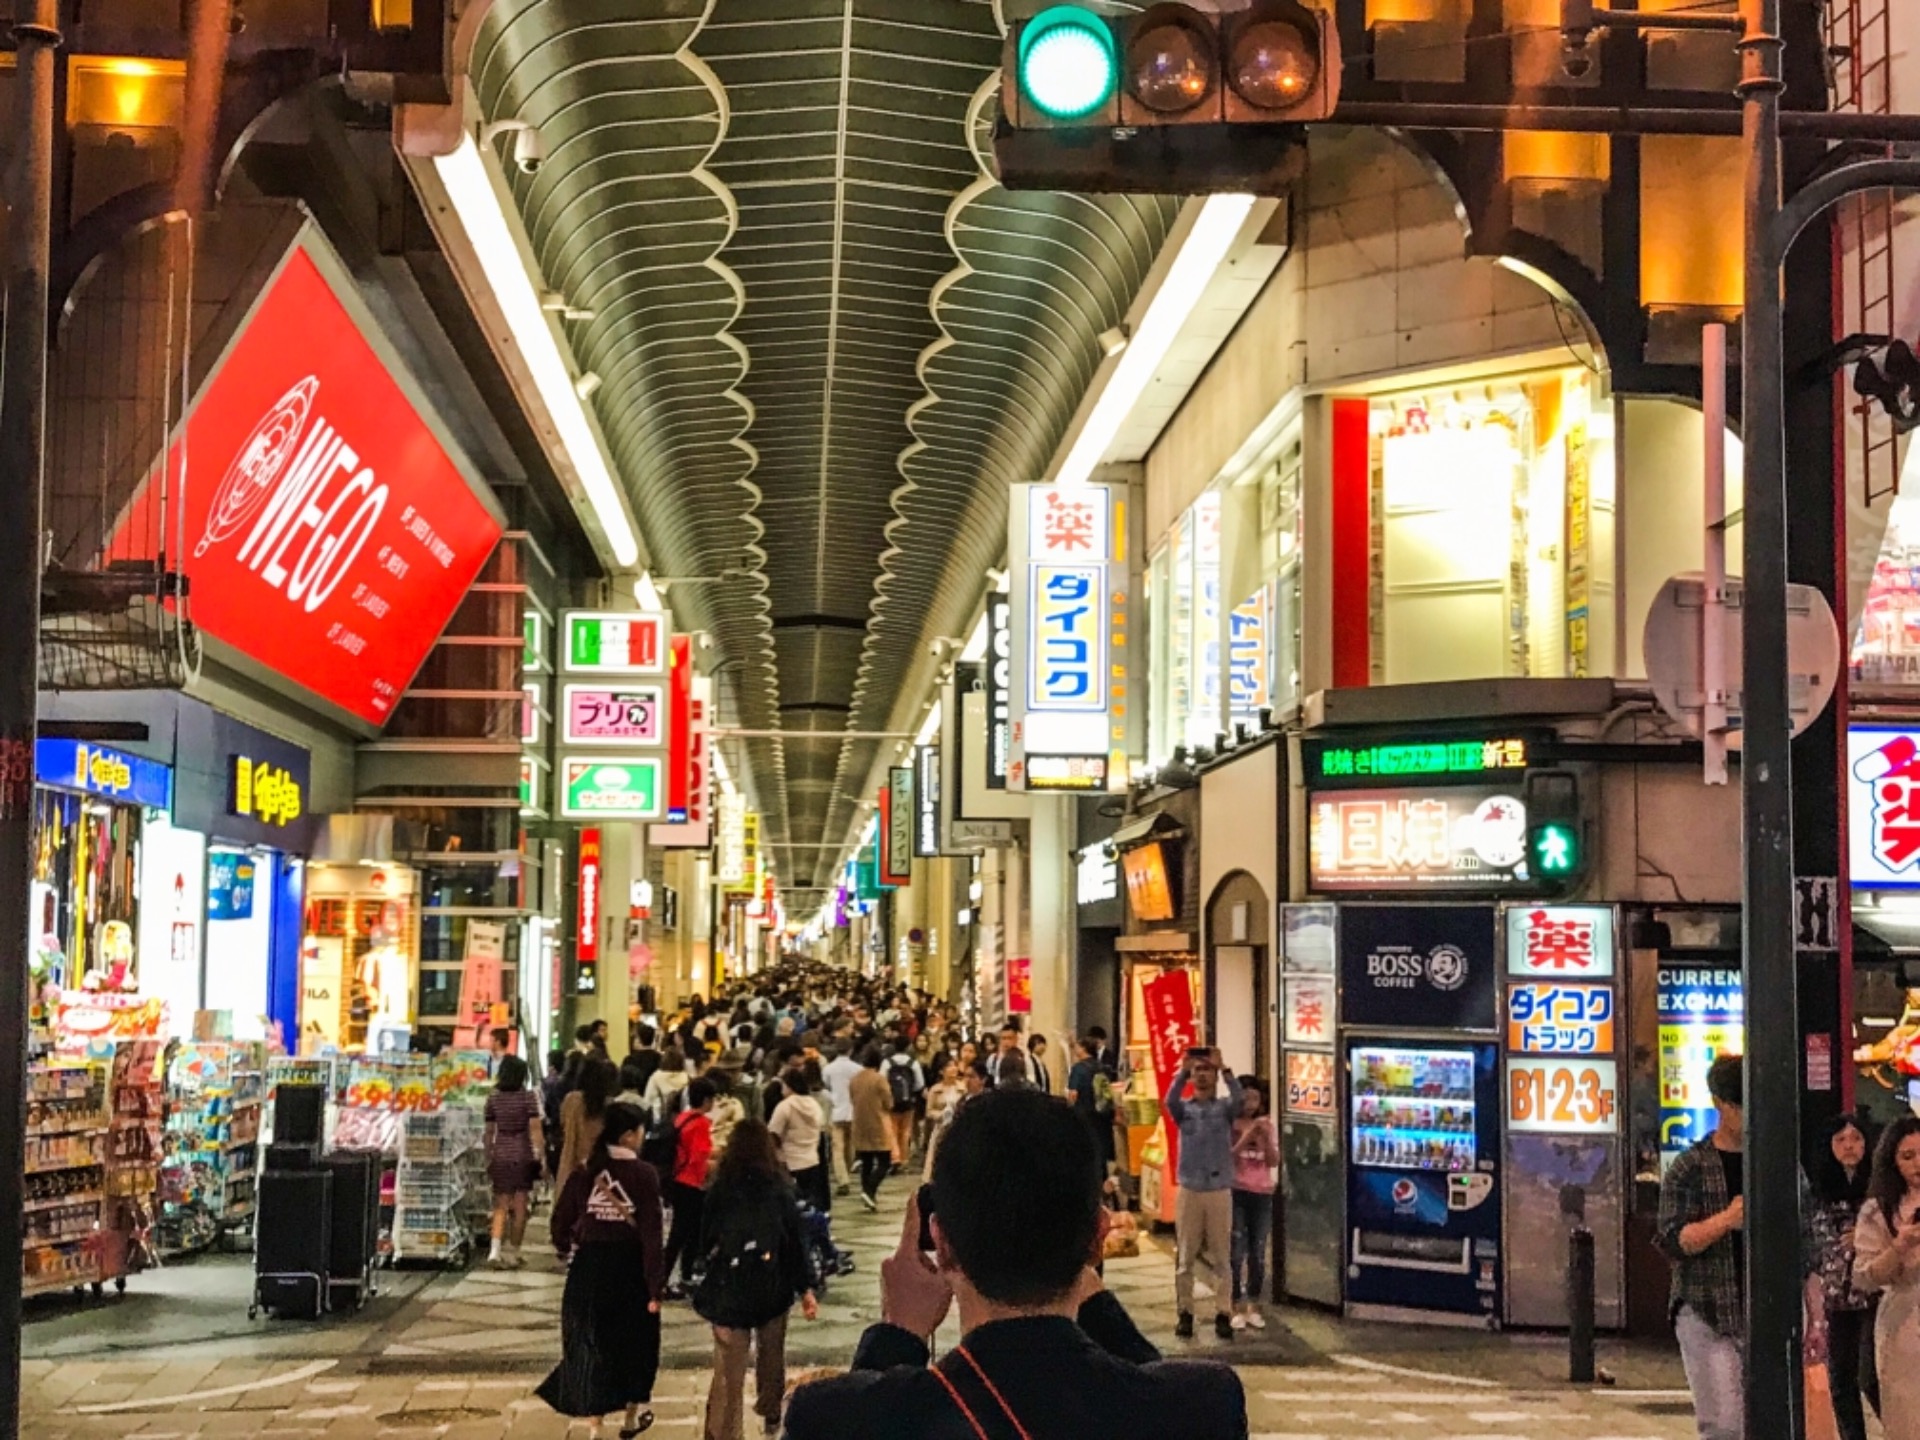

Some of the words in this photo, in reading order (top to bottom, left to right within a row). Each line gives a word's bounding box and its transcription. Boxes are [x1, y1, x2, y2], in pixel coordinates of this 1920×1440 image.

[236, 416, 390, 613] WEGO
[1045, 502, 1094, 551] 薬
[1046, 573, 1093, 698] ダイコク
[1367, 955, 1422, 976] BOSS
[1527, 920, 1593, 969] 薬
[1373, 976, 1416, 988] COFFEE
[1510, 986, 1611, 1022] ダイコク
